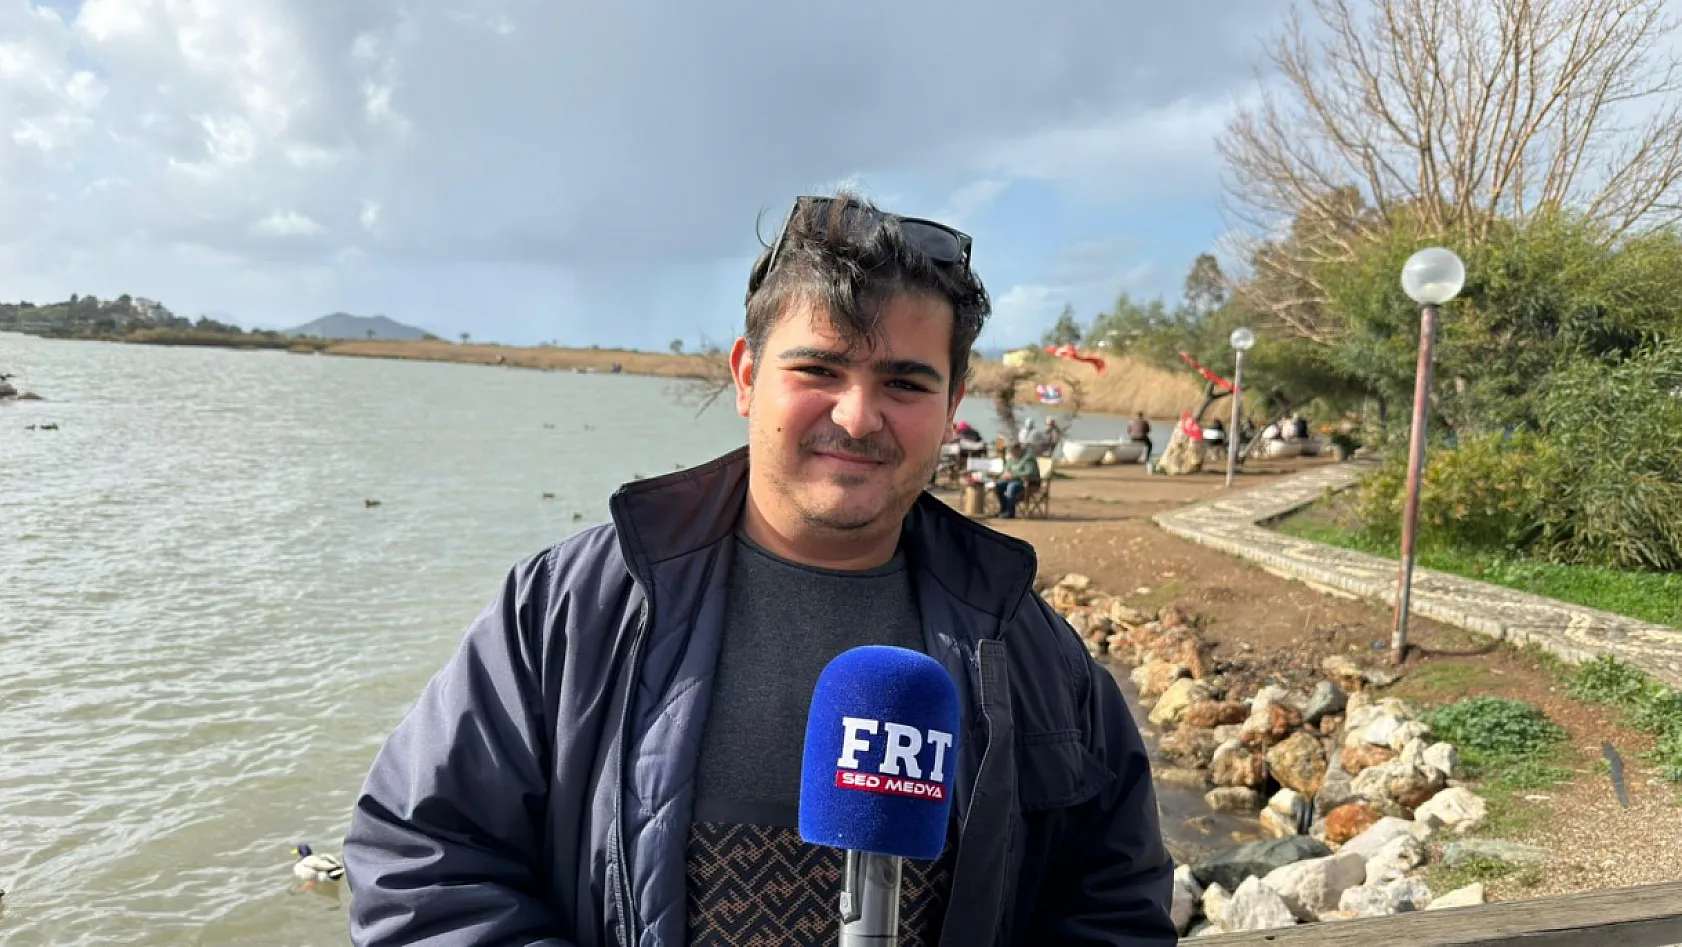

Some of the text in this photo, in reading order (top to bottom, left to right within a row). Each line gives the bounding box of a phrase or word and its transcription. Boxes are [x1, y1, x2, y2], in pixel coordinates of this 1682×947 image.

[837, 716, 953, 782] FRT
[842, 772, 942, 798] SED MEDYA
